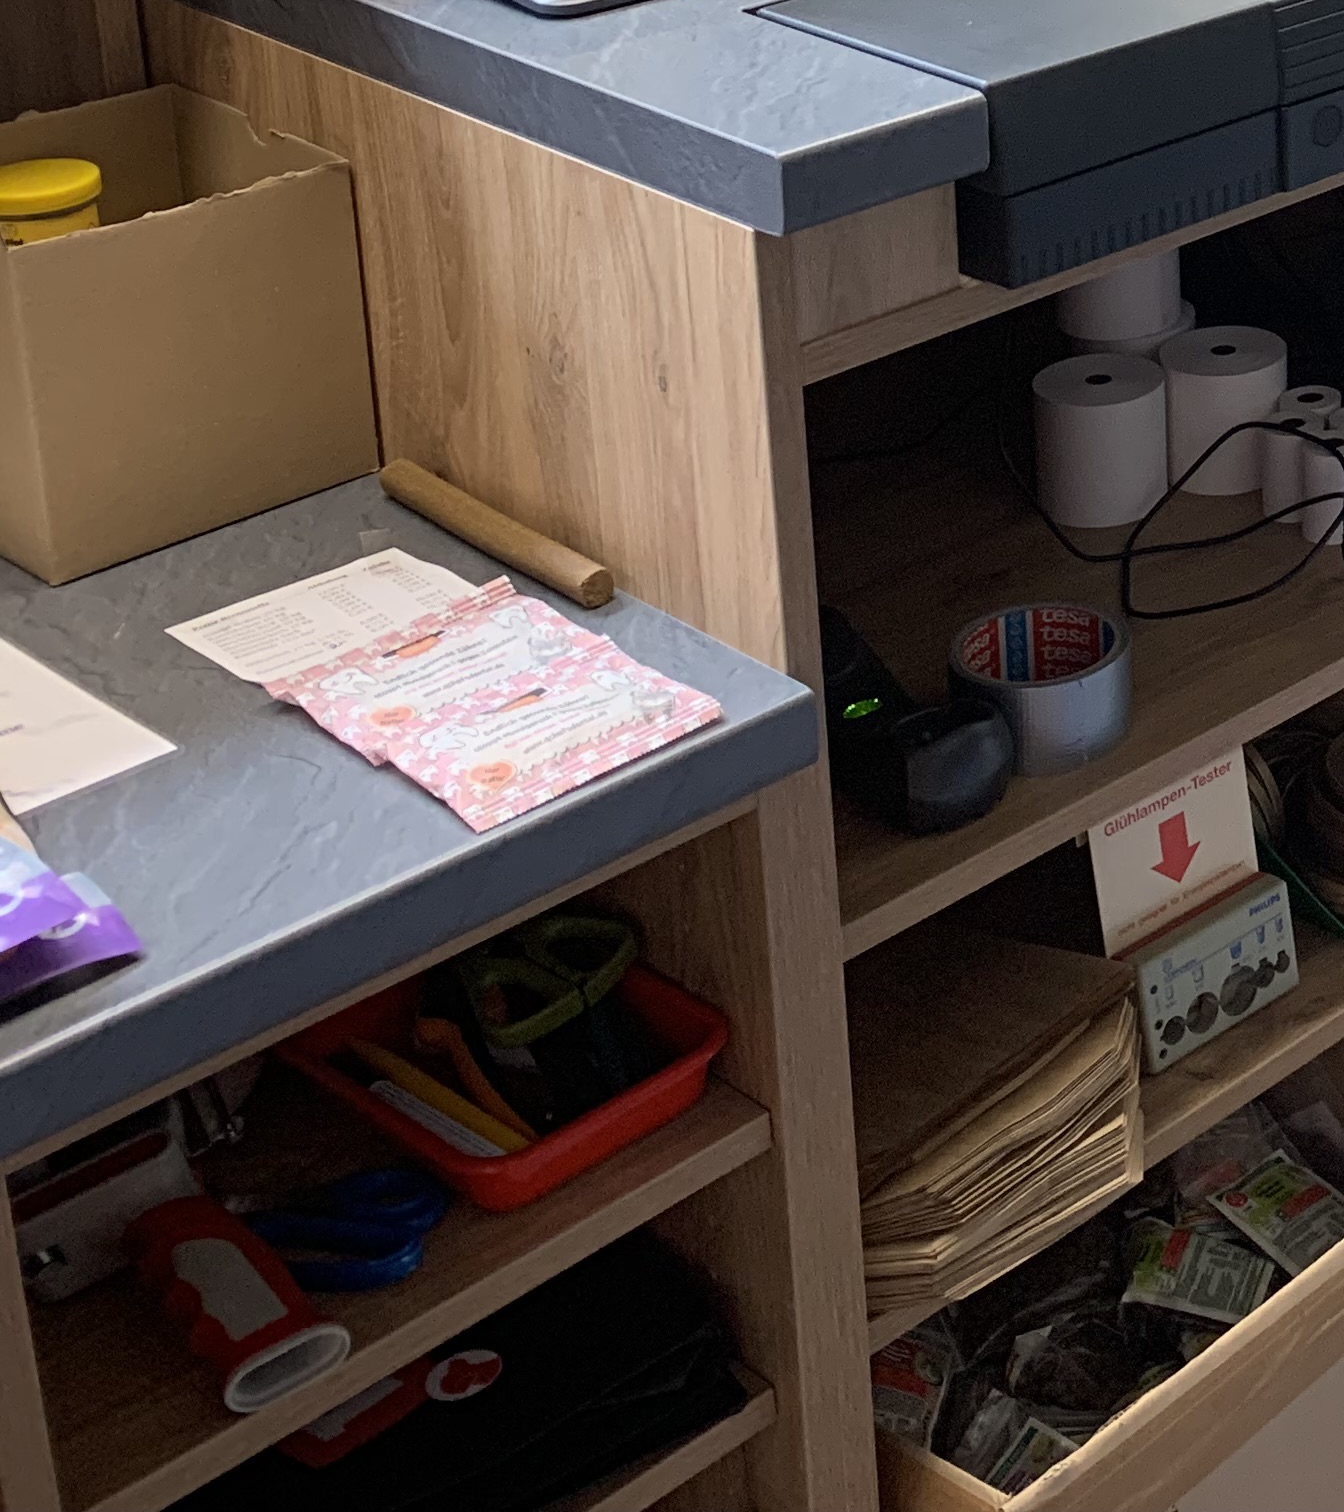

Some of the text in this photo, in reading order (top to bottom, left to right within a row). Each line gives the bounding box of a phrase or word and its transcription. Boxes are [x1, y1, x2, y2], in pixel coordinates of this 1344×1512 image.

[1040, 625, 1092, 646] tesa
[1040, 644, 1093, 663] tesa
[1103, 760, 1232, 838] Glühlampen-Tester
[1248, 892, 1282, 918] PHILIPS
